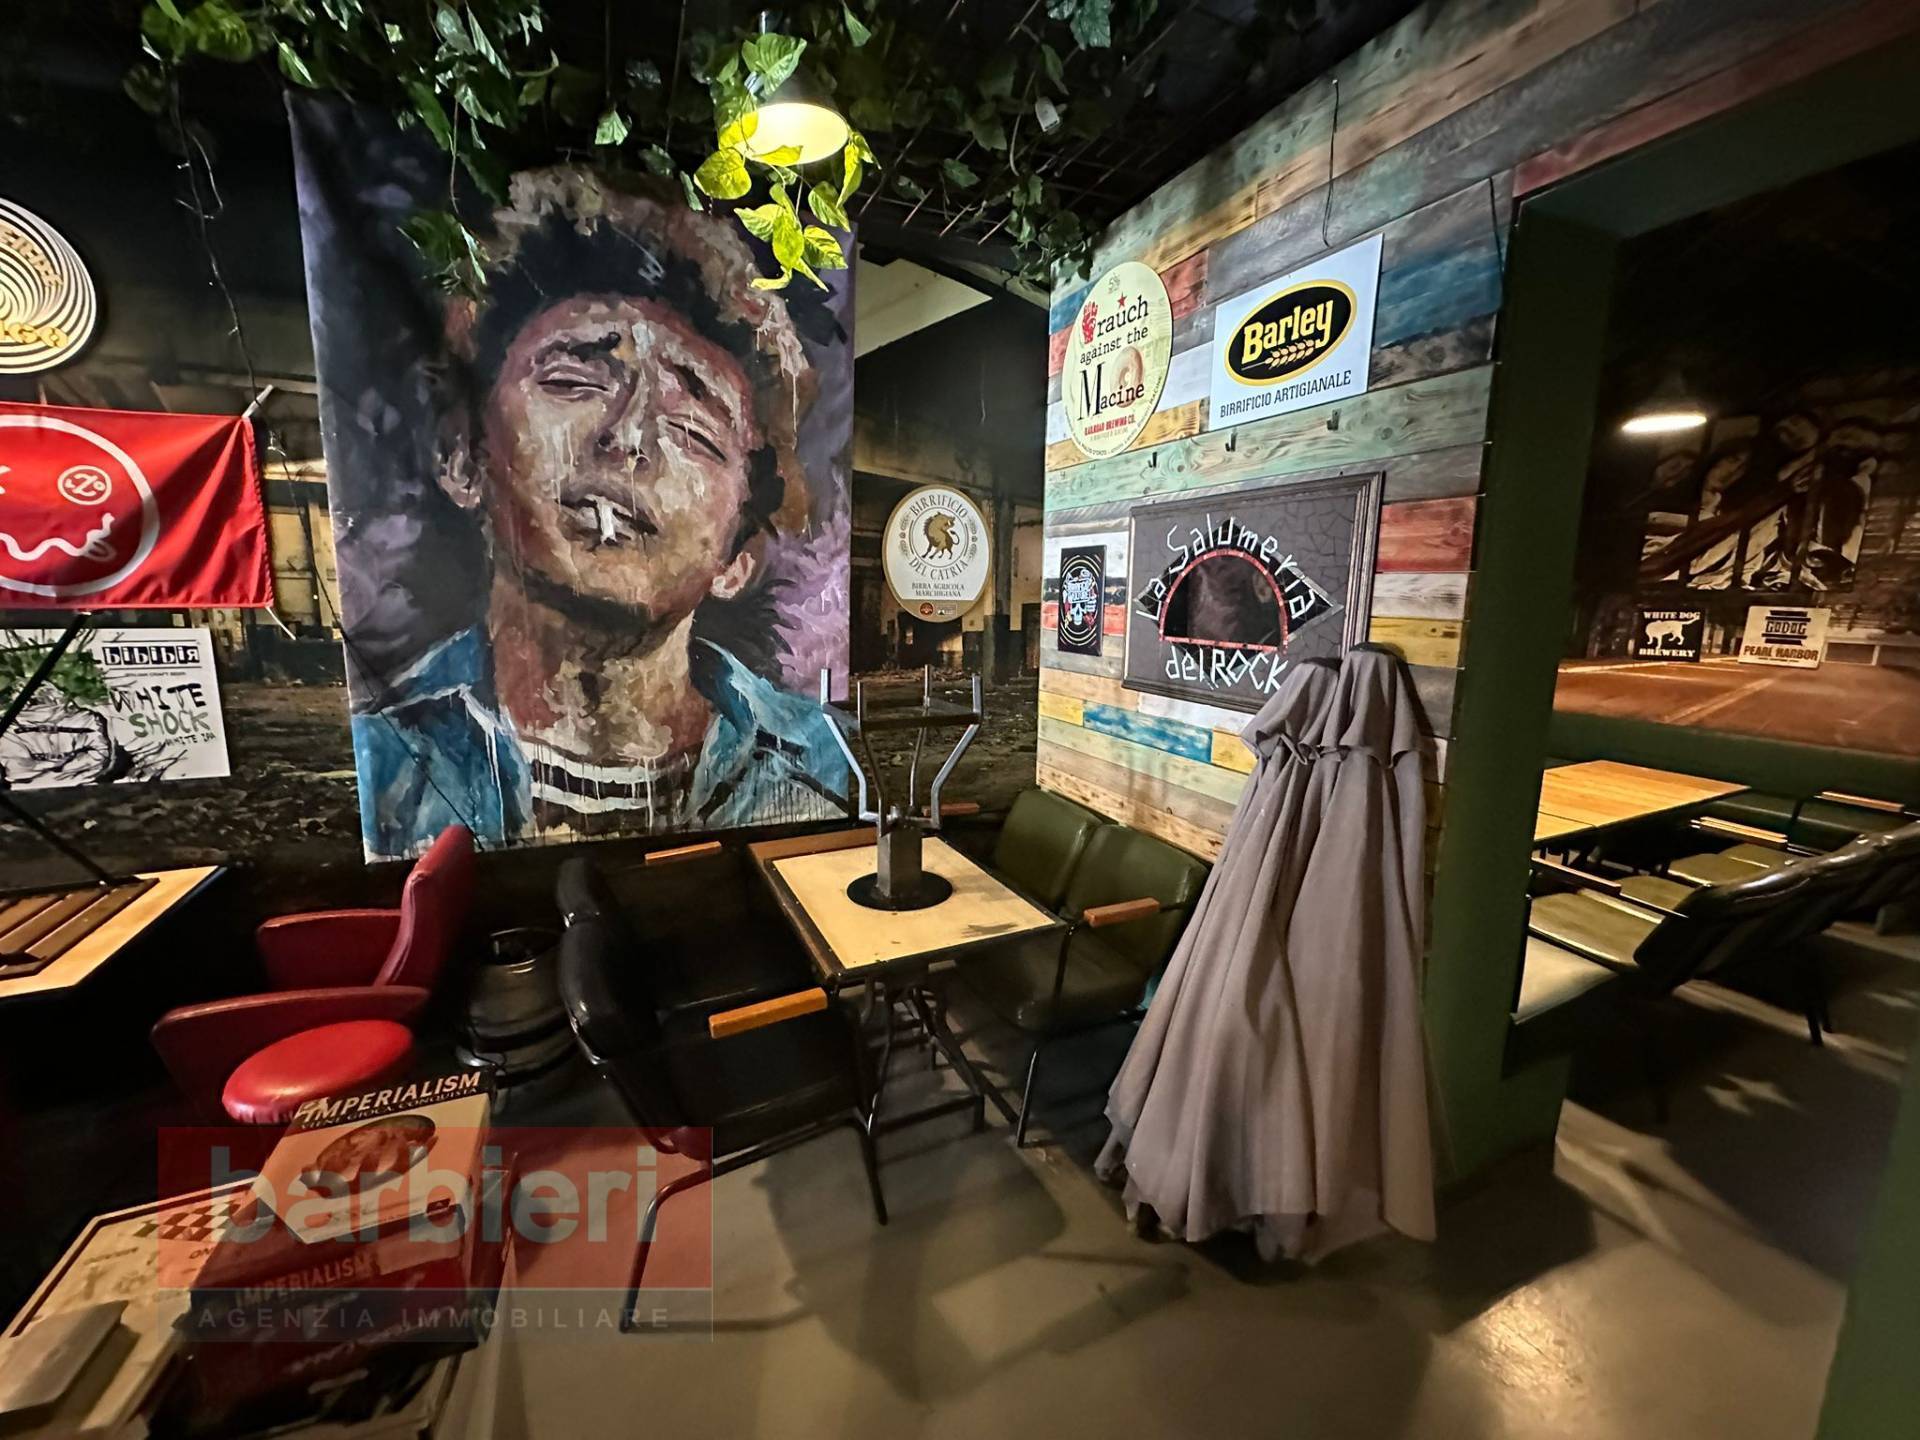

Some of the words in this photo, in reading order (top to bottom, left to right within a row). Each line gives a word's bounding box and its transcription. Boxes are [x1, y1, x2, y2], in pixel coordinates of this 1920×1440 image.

[1097, 295, 1149, 338] rauch
[1241, 300, 1333, 365] Barley
[1080, 338, 1122, 366] against
[1127, 326, 1149, 345] the
[1077, 361, 1145, 422] Macine
[1220, 392, 1272, 418] BIRRIFICIO
[1274, 370, 1351, 404] ARTIGIANALE
[909, 494, 968, 518] BIRRIFICIO
[909, 557, 928, 577] DEL
[930, 559, 968, 581] CATRIA
[1136, 577, 1167, 621] La
[1643, 611, 1678, 619] WHITE
[1679, 611, 1701, 620] DOG
[1639, 648, 1696, 658] BREWERY
[1743, 645, 1772, 657] PEARL
[1775, 647, 1819, 661] HARBOR
[110, 683, 206, 713] WHITE
[129, 711, 211, 738] SHOCK
[303, 1070, 482, 1124] IMPERIALISM
